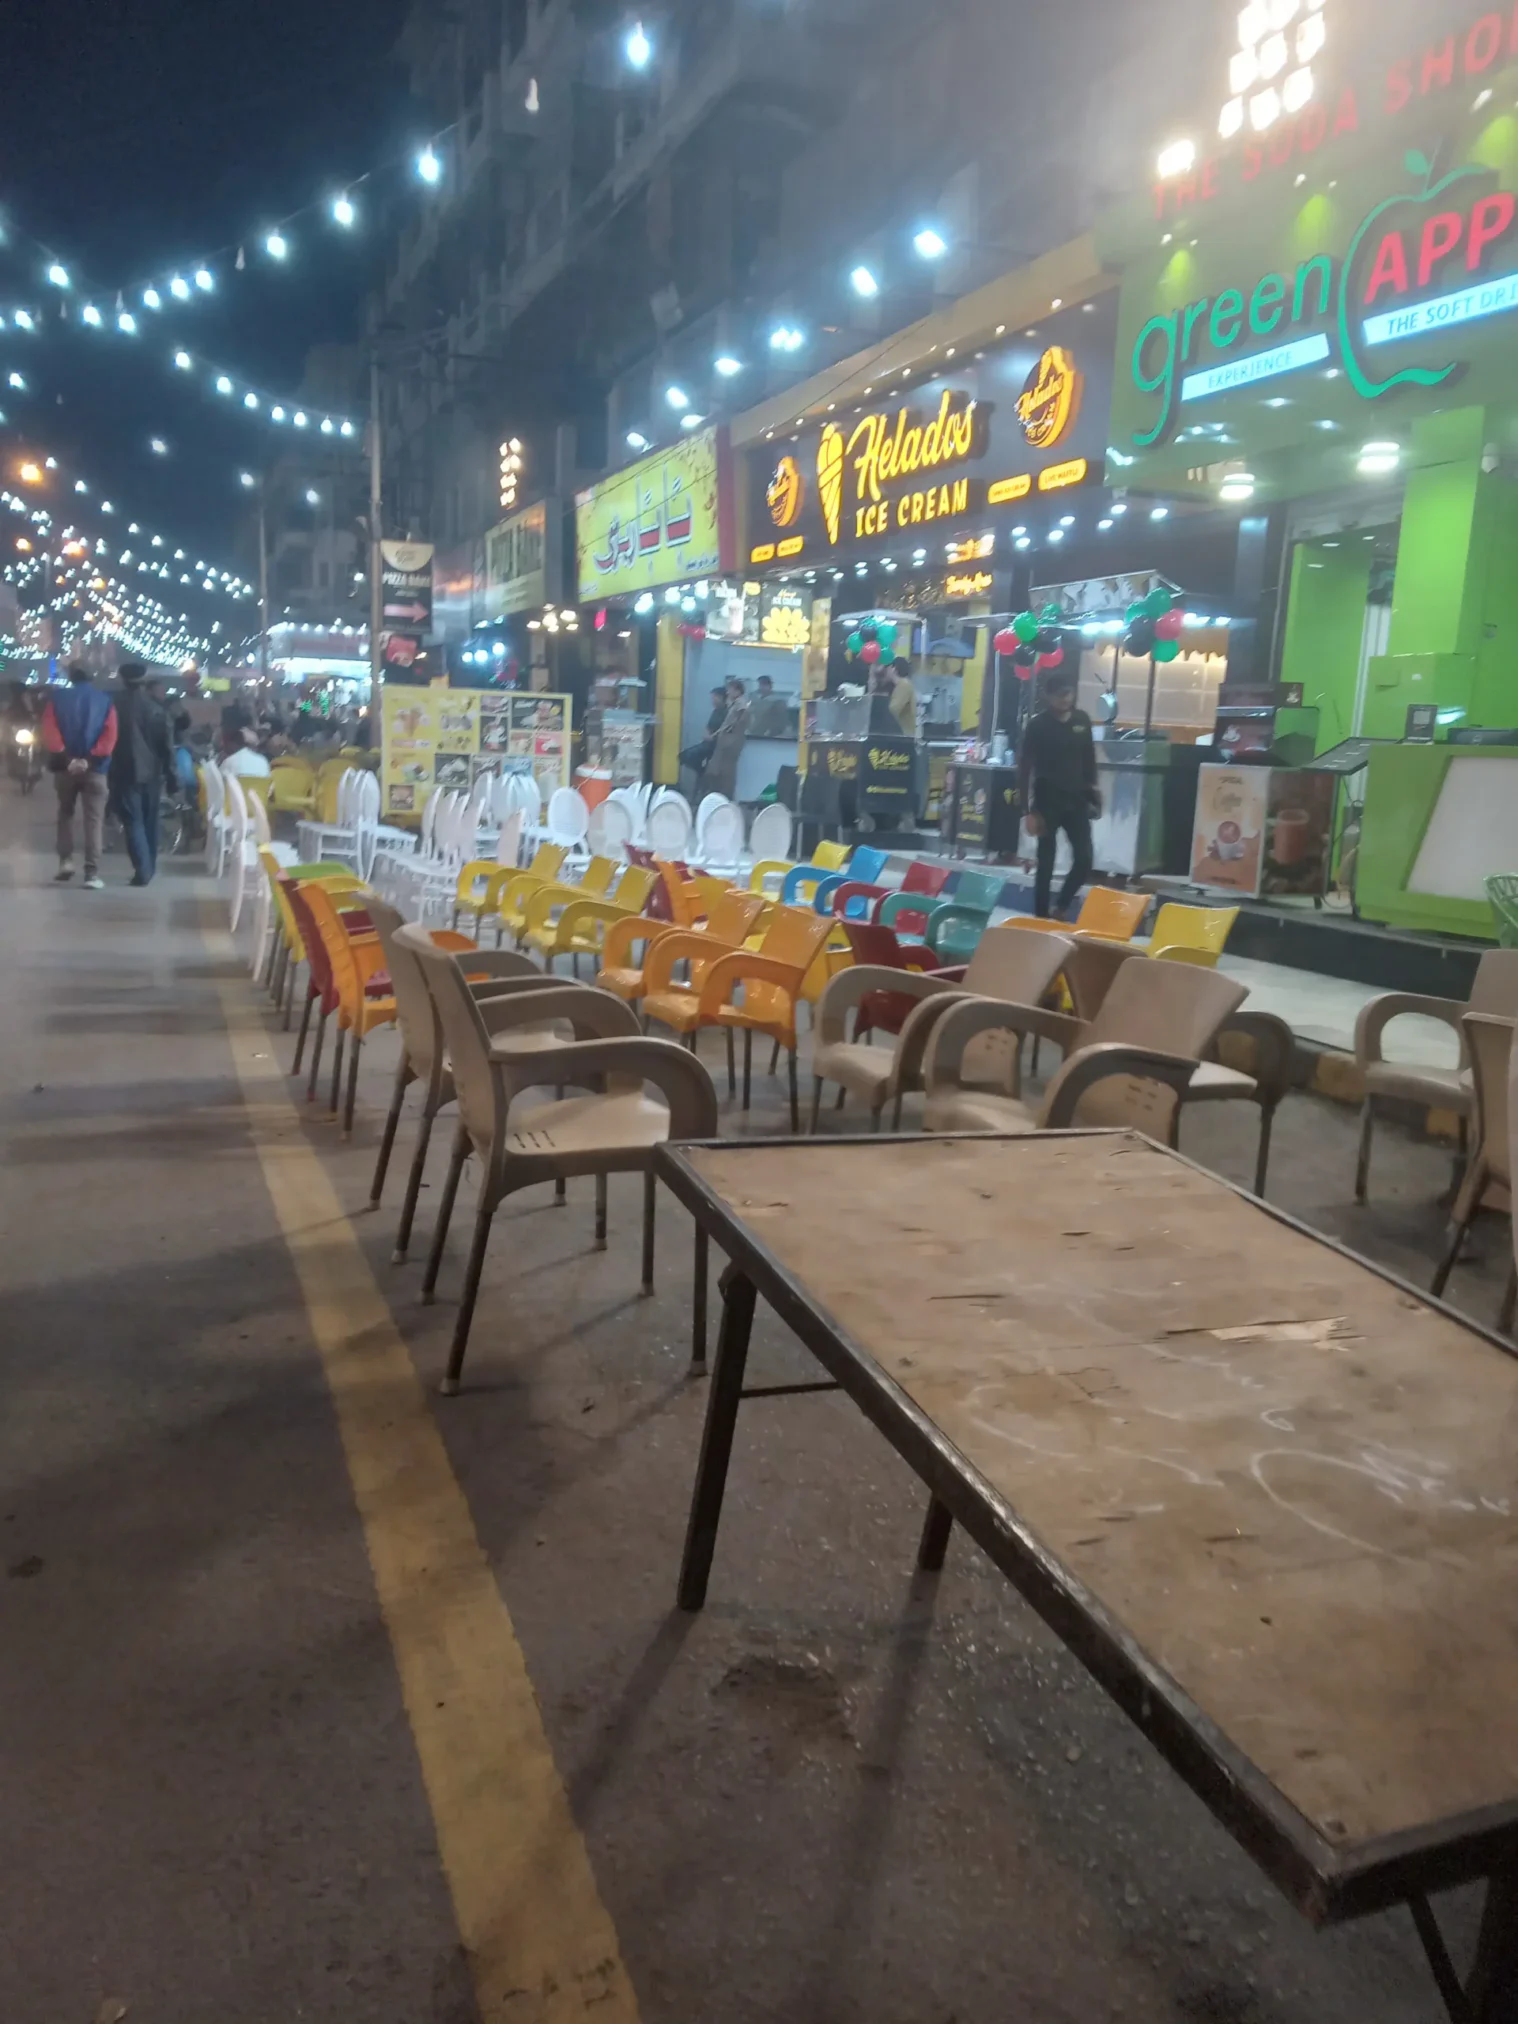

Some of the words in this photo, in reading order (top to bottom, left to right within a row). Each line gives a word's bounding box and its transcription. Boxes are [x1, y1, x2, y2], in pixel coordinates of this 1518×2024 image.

[1388, 312, 1420, 336] THE
[1426, 296, 1474, 325] SOFT
[1132, 252, 1332, 446] green
[1208, 351, 1293, 388] EXPERIENCE
[845, 389, 977, 503] Helados
[855, 501, 888, 539] ICE
[897, 478, 968, 527] CREAM
